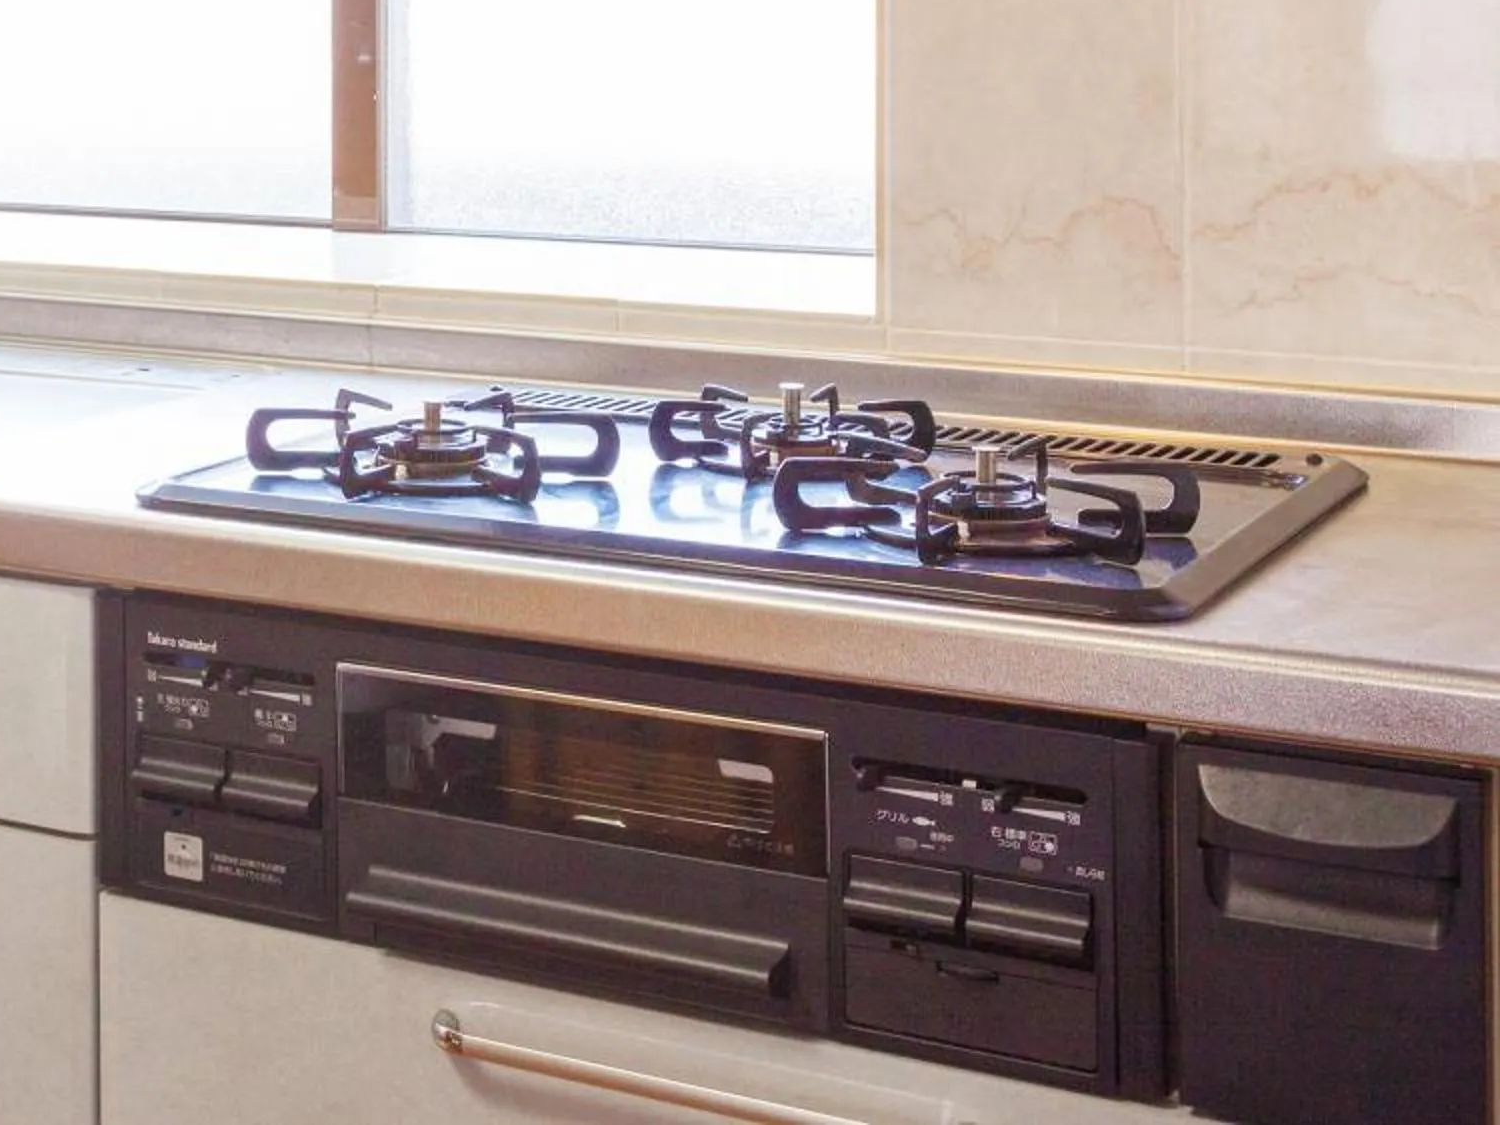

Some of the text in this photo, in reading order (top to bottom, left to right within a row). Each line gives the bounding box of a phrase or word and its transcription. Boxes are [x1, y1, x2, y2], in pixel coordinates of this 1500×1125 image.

[178, 637, 218, 654] standard
[875, 808, 910, 824] グリル
